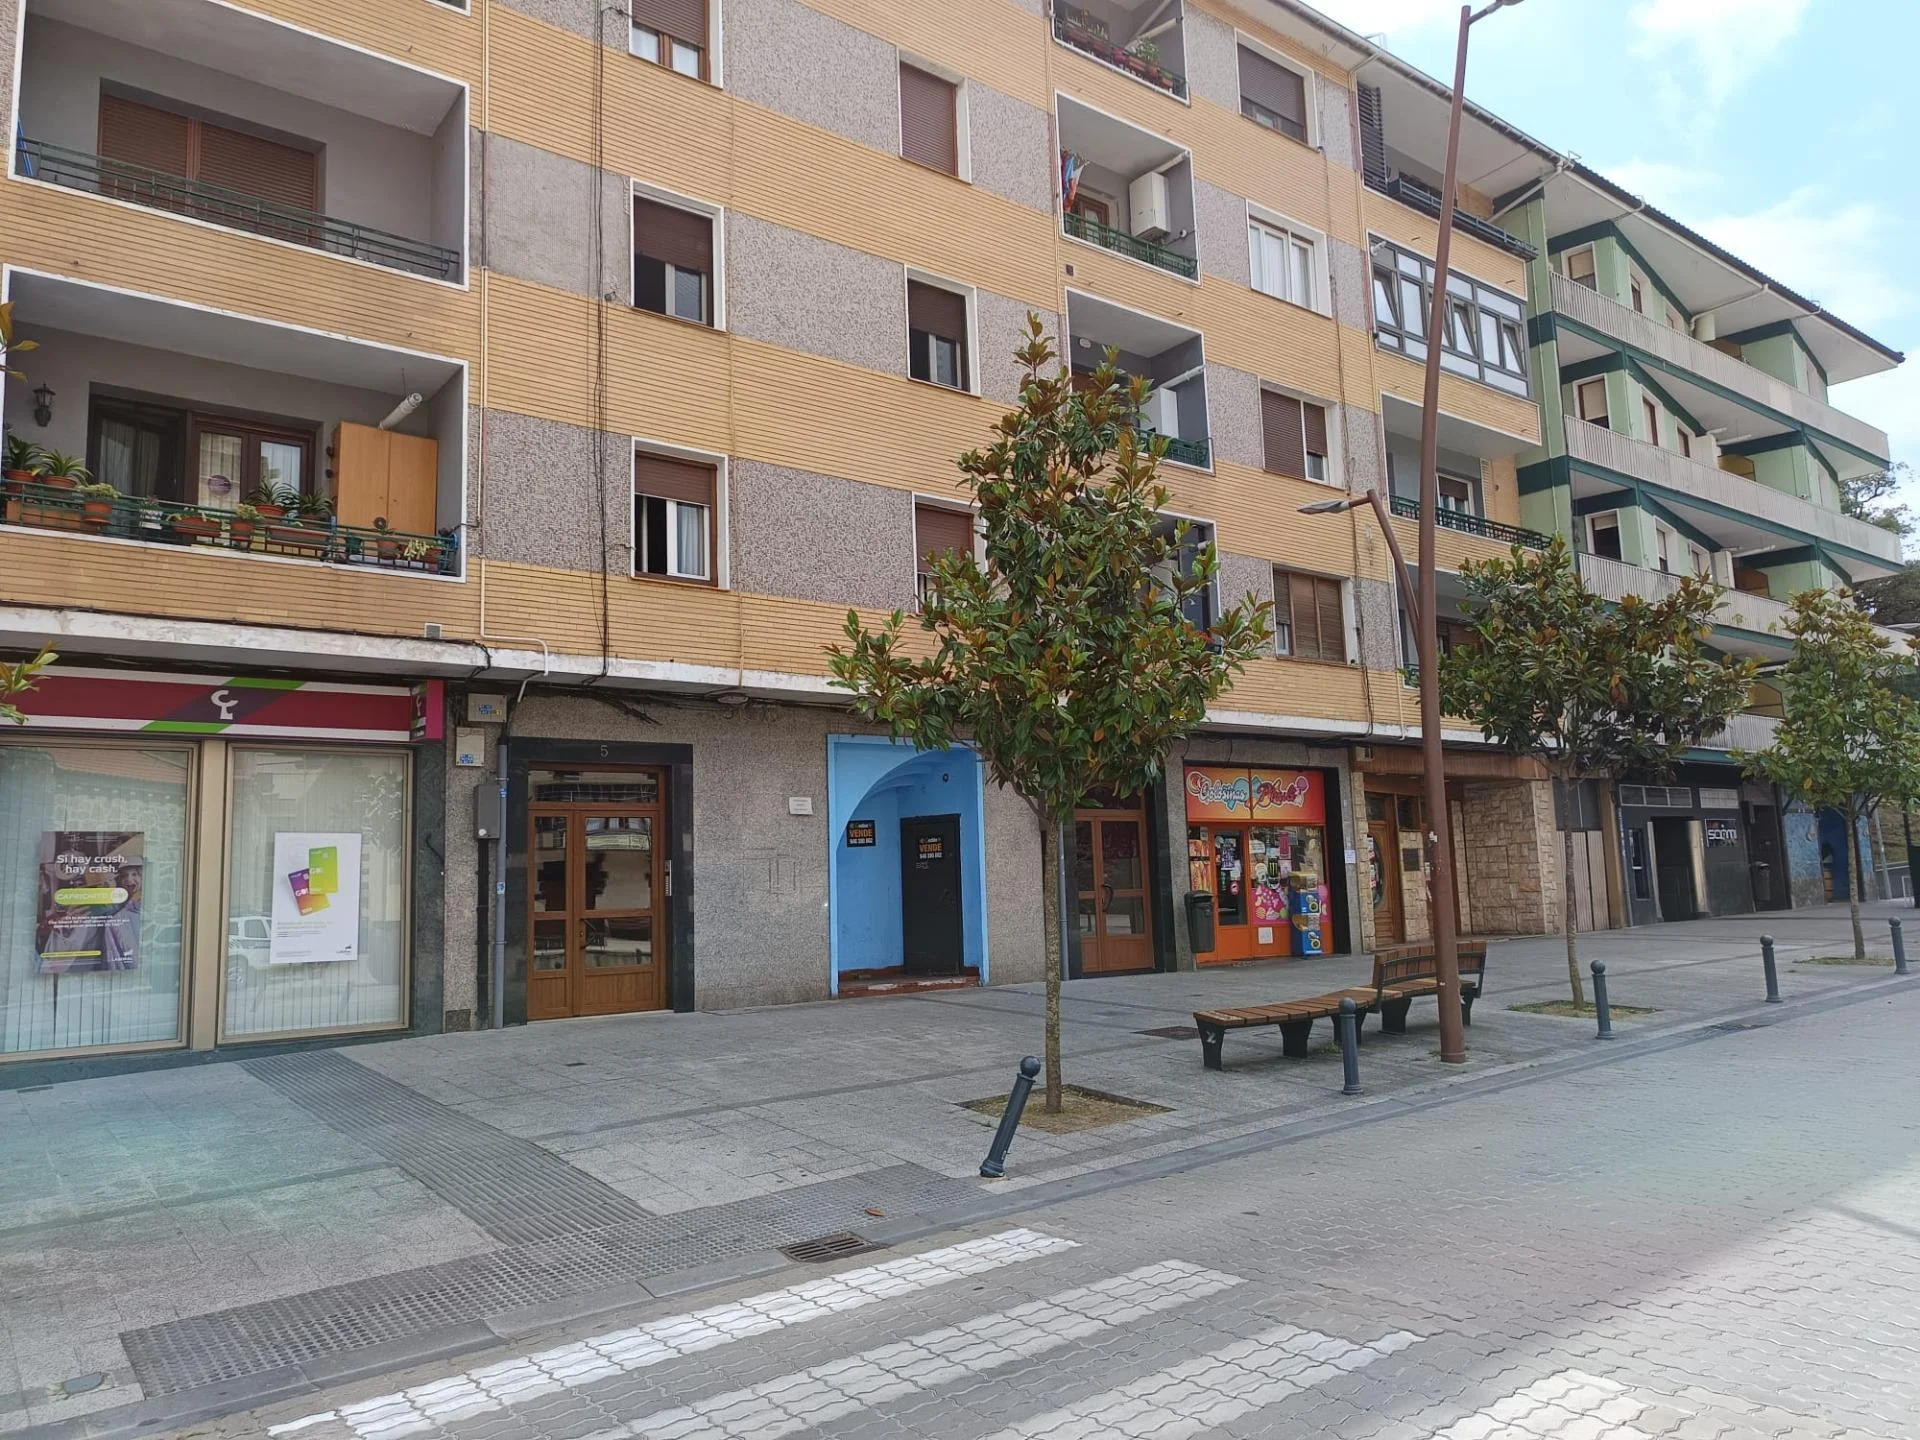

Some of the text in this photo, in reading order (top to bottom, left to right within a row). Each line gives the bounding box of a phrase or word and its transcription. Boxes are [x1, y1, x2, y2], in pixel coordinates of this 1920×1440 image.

[600, 744, 609, 758] 5
[850, 828, 873, 838] VENDE
[919, 843, 943, 852] VENDE
[56, 854, 128, 865] Si hay crush,
[65, 864, 118, 875] hay cash.
